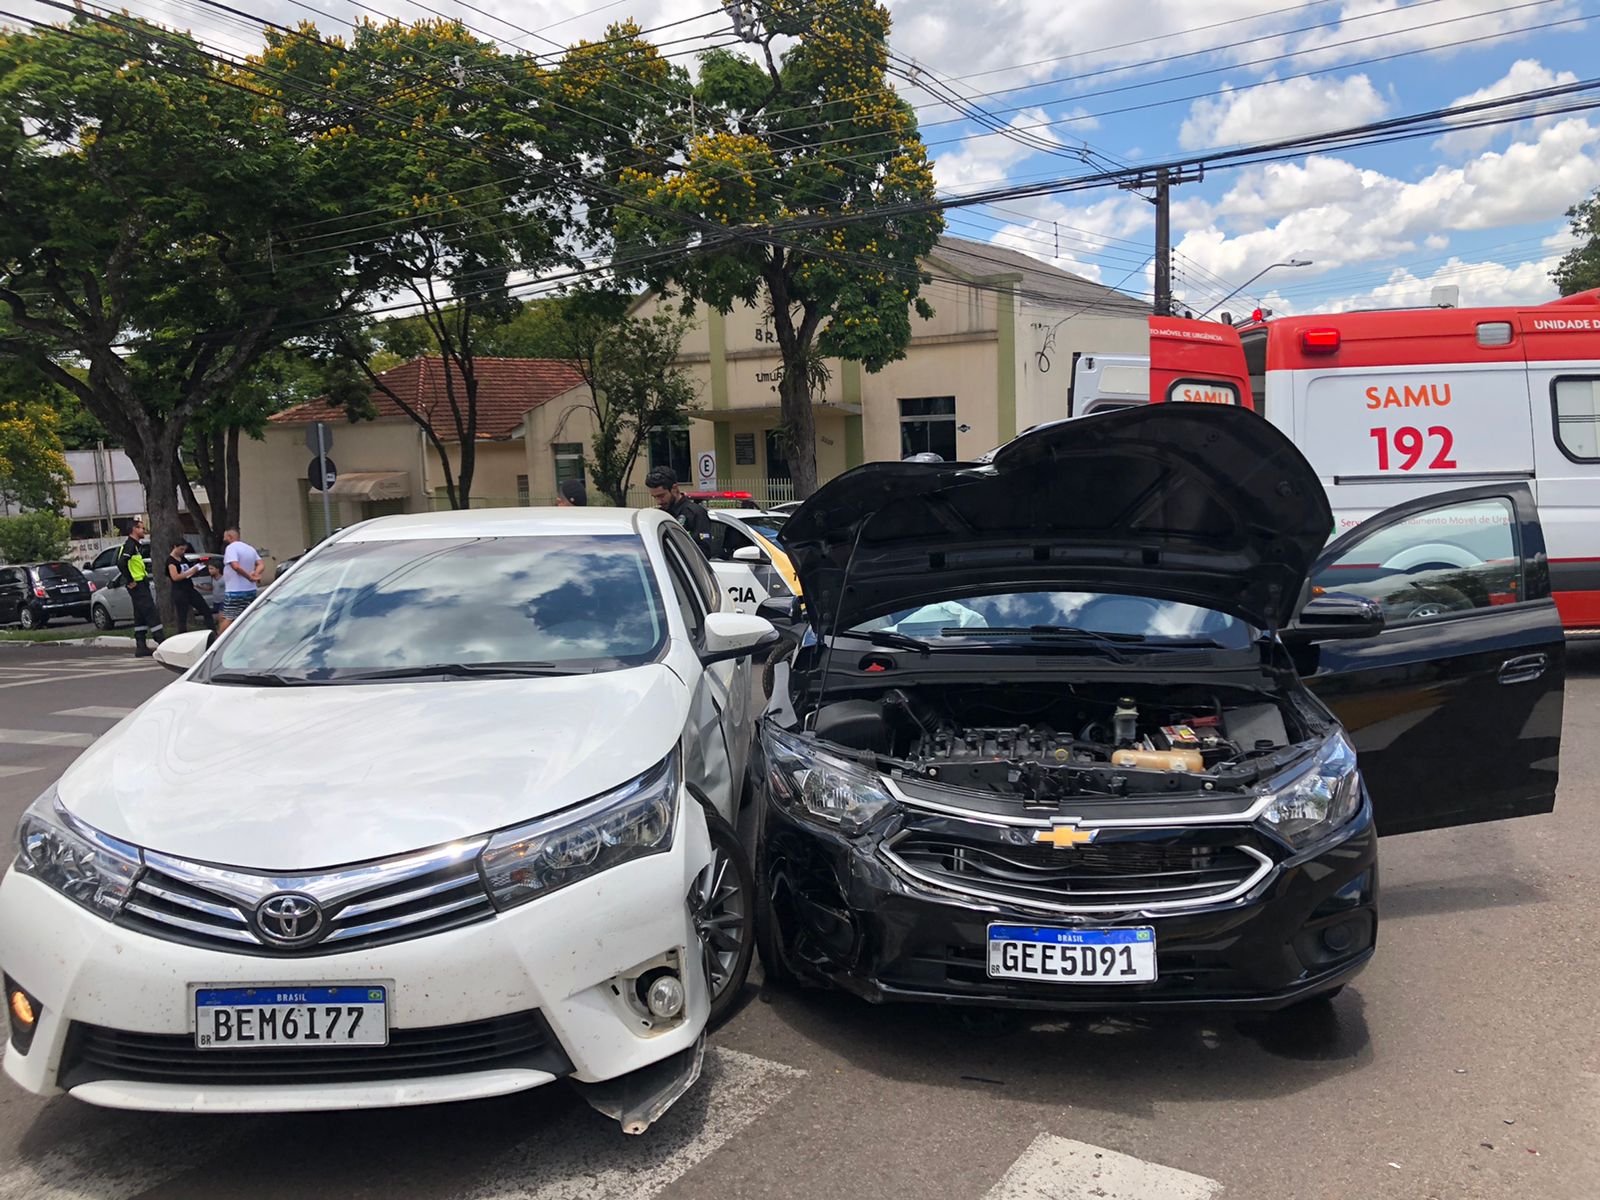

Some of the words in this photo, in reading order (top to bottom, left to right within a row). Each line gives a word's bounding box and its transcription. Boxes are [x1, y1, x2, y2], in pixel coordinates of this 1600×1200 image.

[1534, 319, 1592, 329] UNIDADE
[1593, 319, 1600, 328] D
[1365, 383, 1452, 409] SAMU
[1370, 425, 1457, 471] 192
[703, 459, 710, 472] E
[1341, 518, 1361, 527] Serv
[1479, 515, 1490, 524] de
[728, 587, 757, 603] CIA
[1057, 934, 1084, 943] BRASIL
[1002, 942, 1137, 976] GEE5D91
[991, 964, 1000, 975] BR
[277, 993, 307, 1001] BRASIL
[214, 1006, 364, 1042] BEM6I77
[200, 1035, 212, 1046] BR
